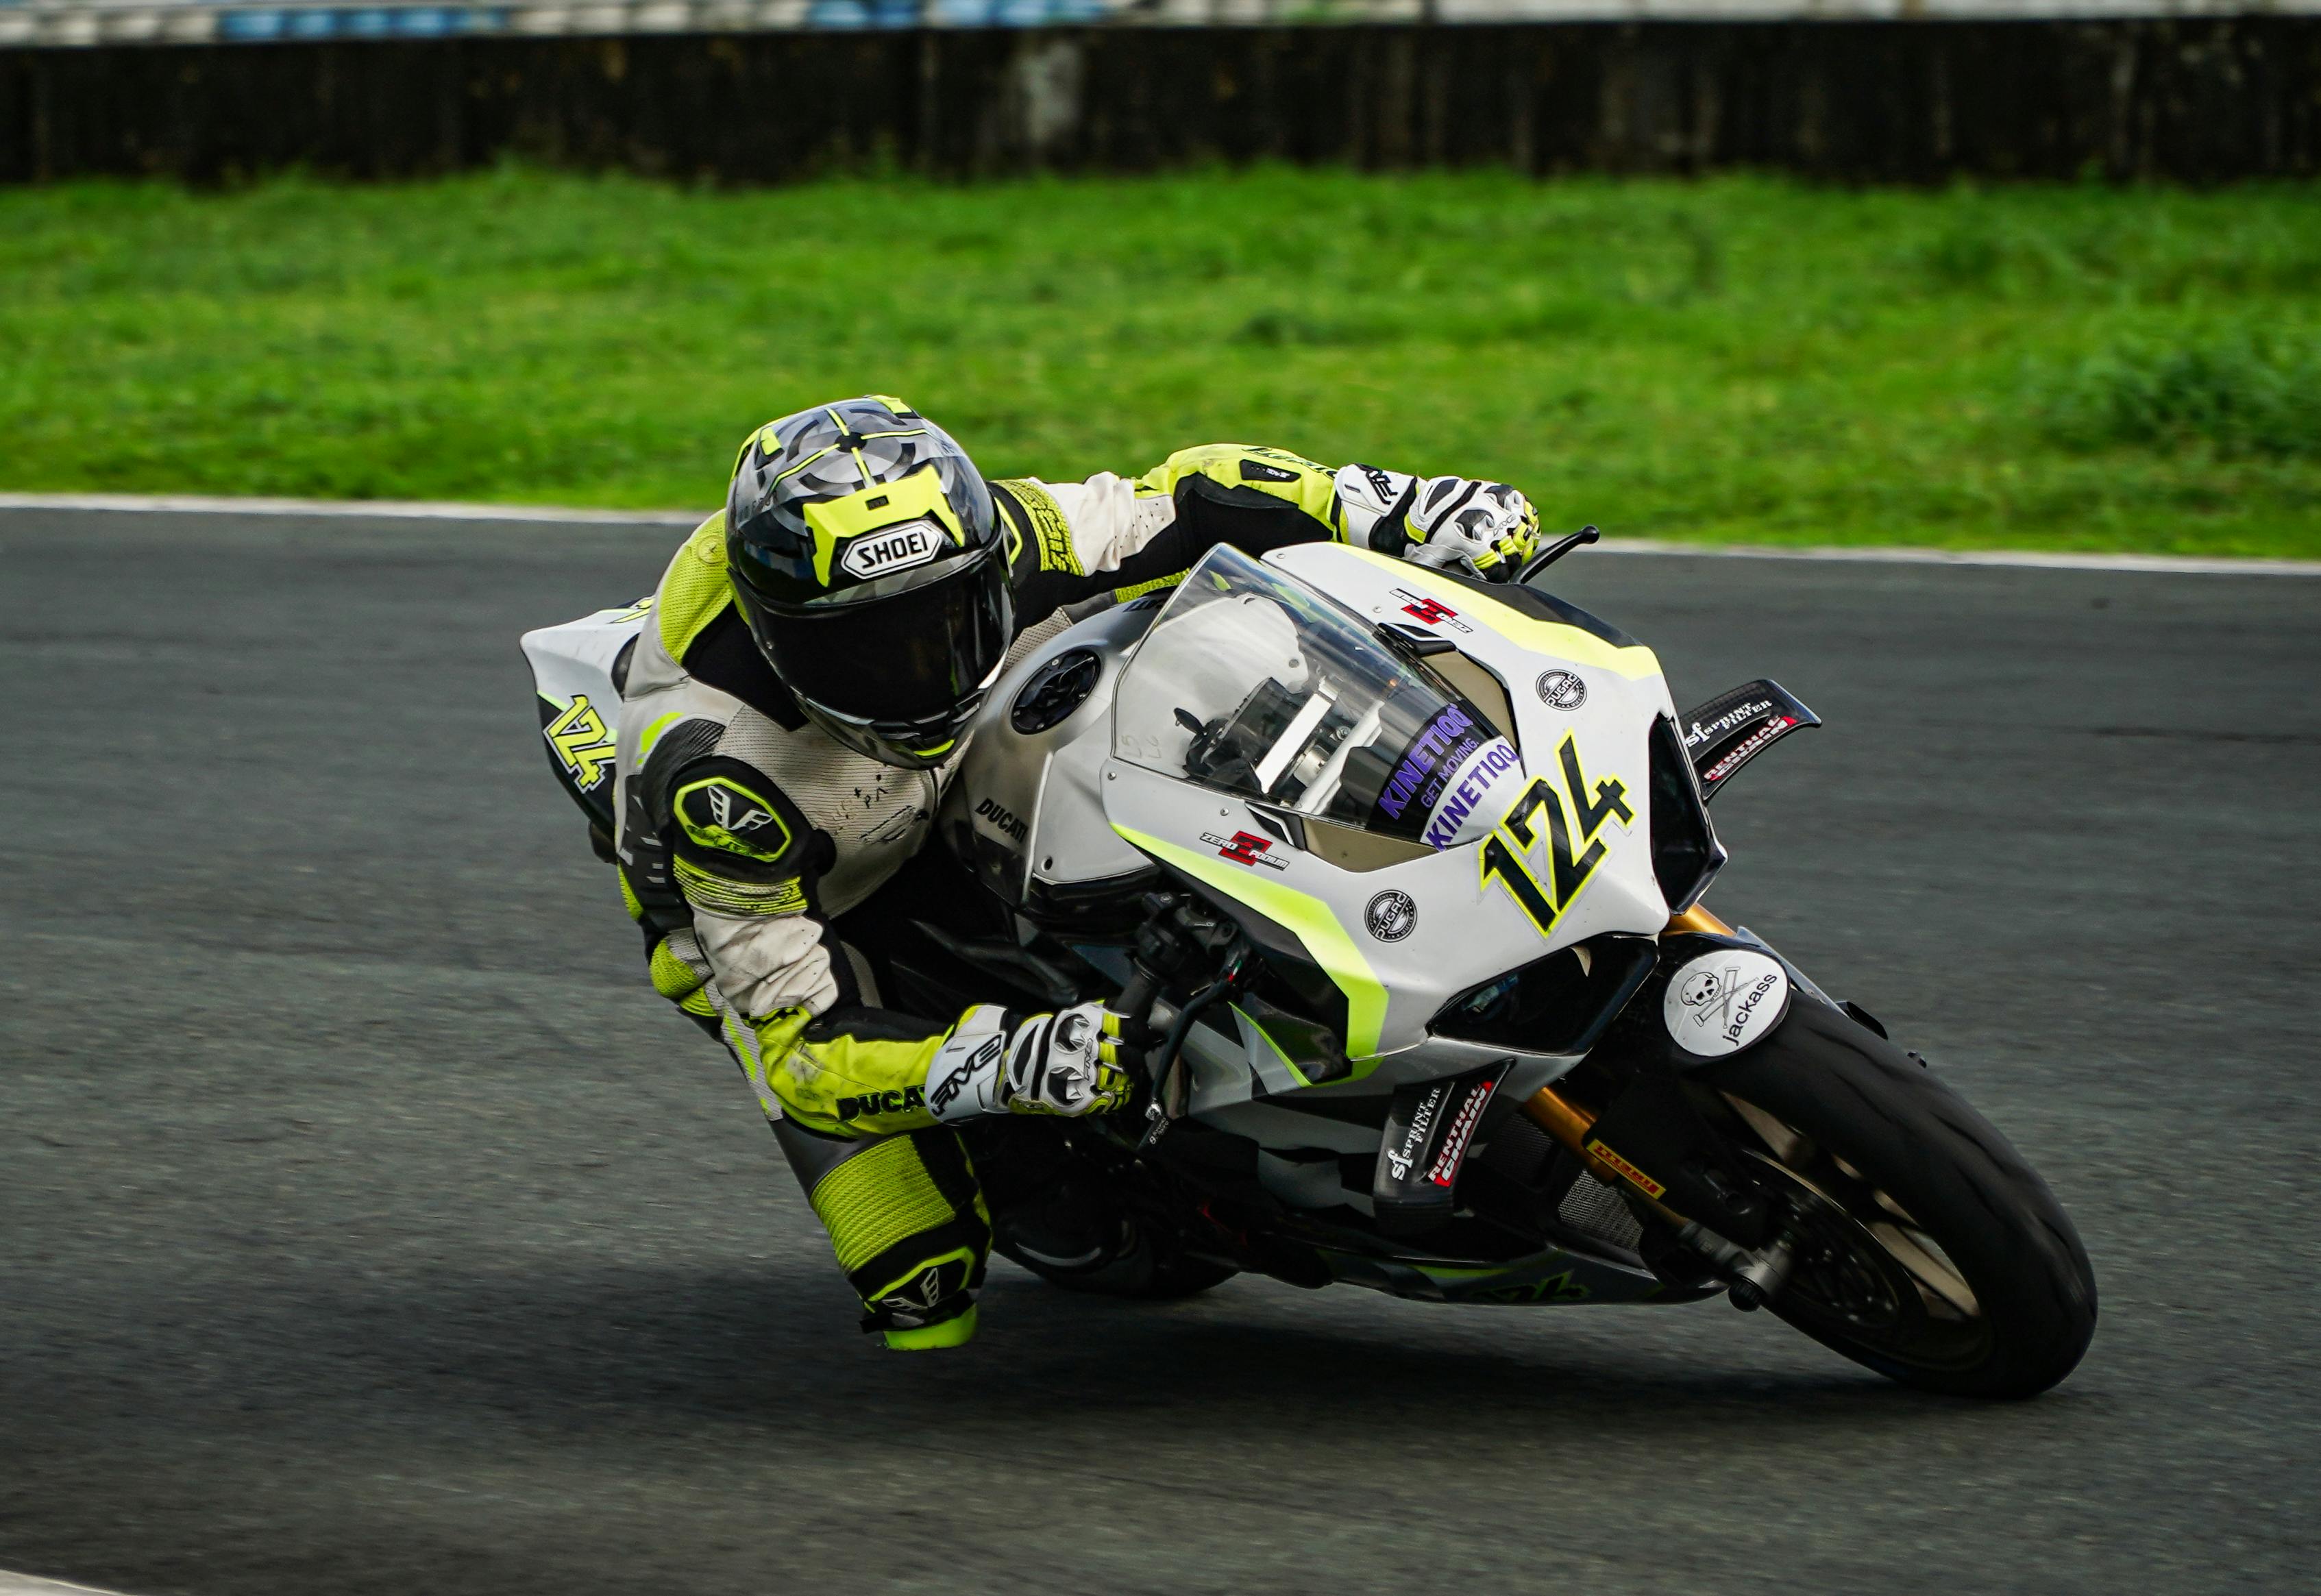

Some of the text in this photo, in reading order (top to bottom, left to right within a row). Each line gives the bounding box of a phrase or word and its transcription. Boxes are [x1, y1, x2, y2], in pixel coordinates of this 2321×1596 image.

[857, 532, 928, 569] SHOEI
[547, 694, 615, 787] 124
[1704, 702, 1752, 735] SPRINT
[1722, 700, 1772, 730] FILTER
[1704, 715, 1780, 780] RENTHAL
[974, 798, 1029, 843] DUCATI
[1421, 778, 1444, 809] GET
[1201, 833, 1289, 870] ZERO PODIUM
[1480, 728, 1636, 939] 124
[1722, 974, 1778, 1046] jackass
[930, 1033, 1002, 1117] FIVE
[1402, 1101, 1427, 1159] SPRINT
[1414, 1088, 1441, 1144] FILTER
[1428, 1084, 1482, 1181] RENTHAL
[1441, 1088, 1487, 1181] CHAIN
